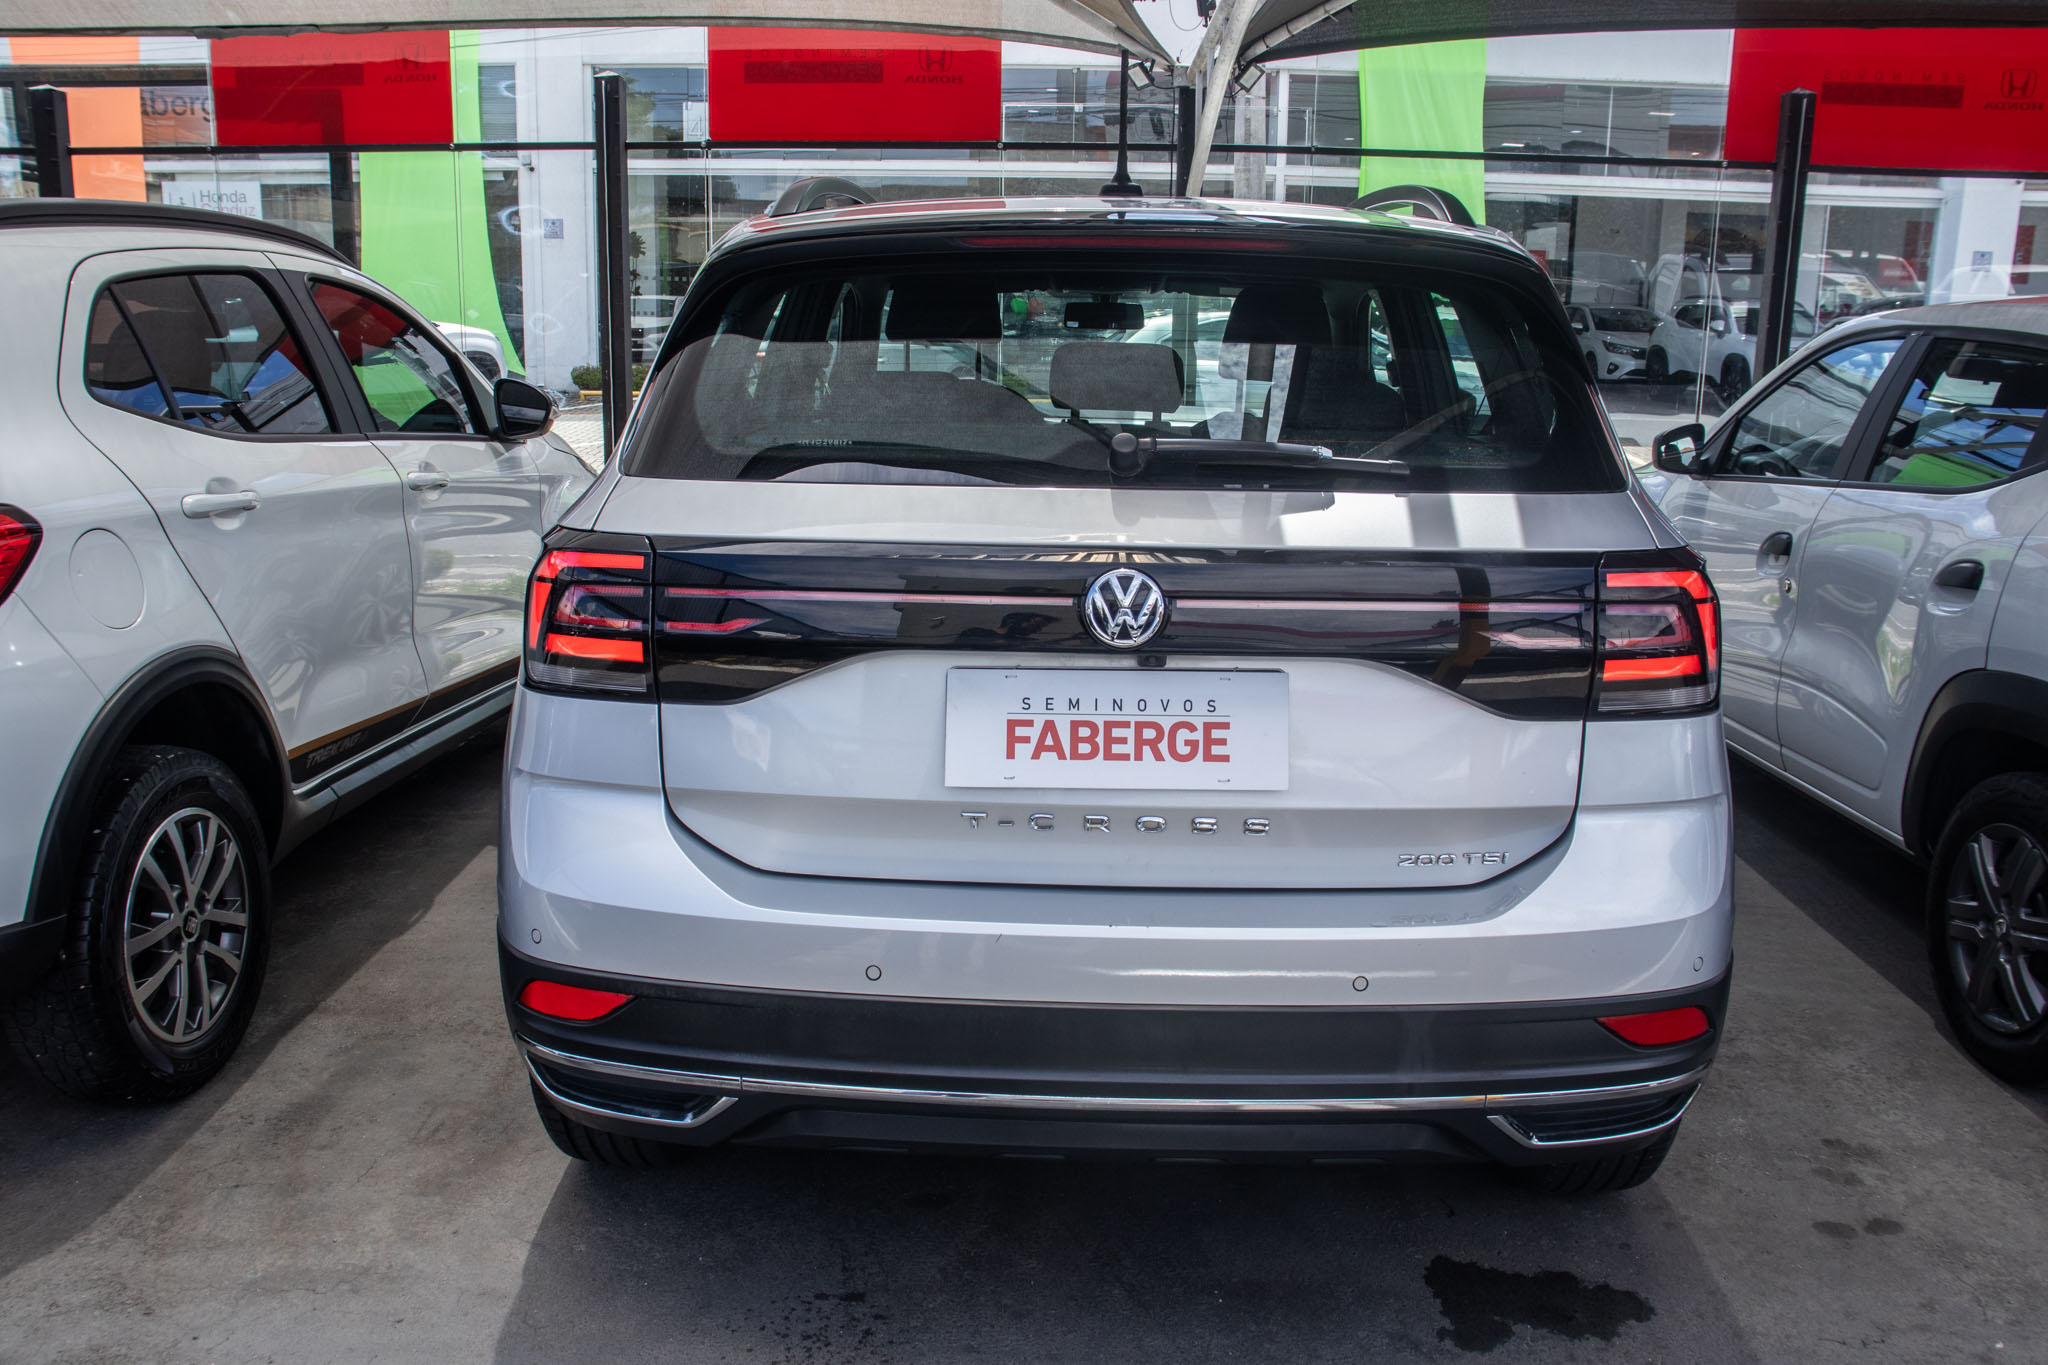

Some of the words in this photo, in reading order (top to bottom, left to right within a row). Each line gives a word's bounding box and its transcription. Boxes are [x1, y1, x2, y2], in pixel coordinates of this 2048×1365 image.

[199, 190, 248, 203] Honda
[1021, 697, 1217, 713] SEMINOVOS
[1005, 718, 1231, 763] FABERGE
[960, 810, 1271, 836] T-CROSS
[1398, 853, 1457, 868] 200
[1462, 851, 1510, 865] TSI
